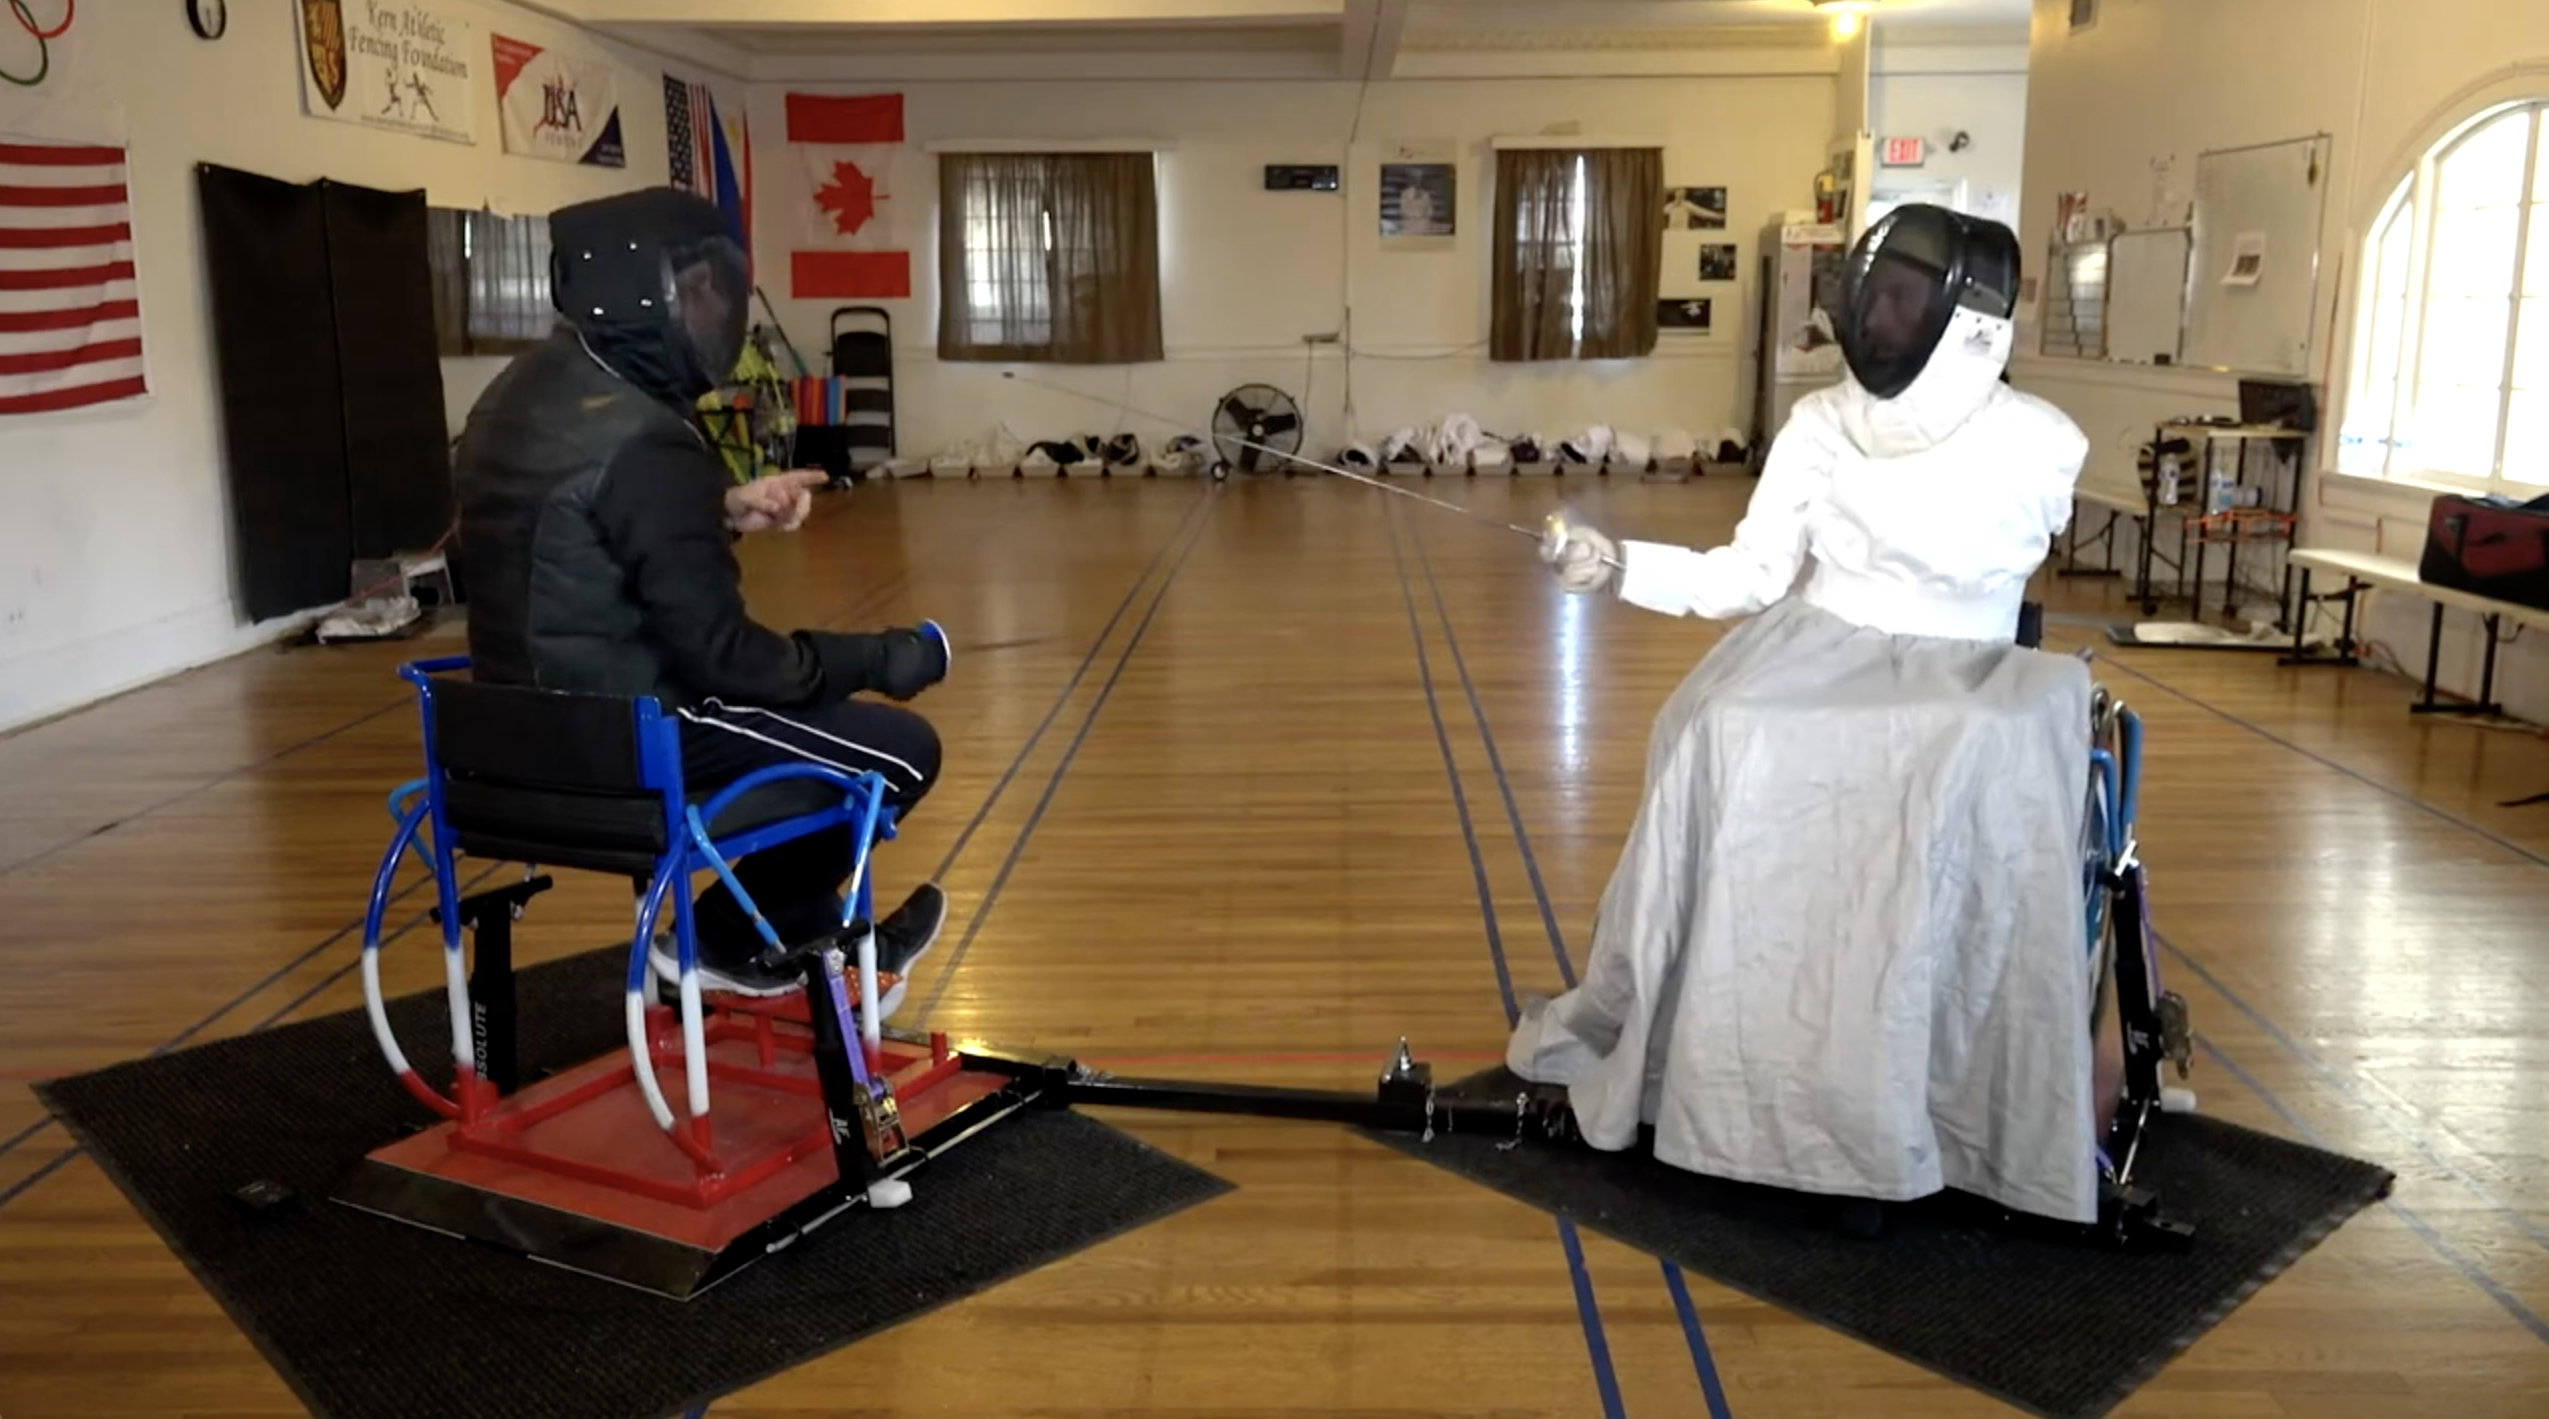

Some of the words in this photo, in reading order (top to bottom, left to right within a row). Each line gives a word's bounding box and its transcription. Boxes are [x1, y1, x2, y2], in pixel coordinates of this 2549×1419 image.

[366, 0, 398, 30] Kern
[398, 9, 445, 46] Athletic
[348, 25, 398, 70] Fencing
[402, 39, 469, 79] Foundation
[542, 82, 582, 132] USA
[1888, 138, 1918, 162] EXIT
